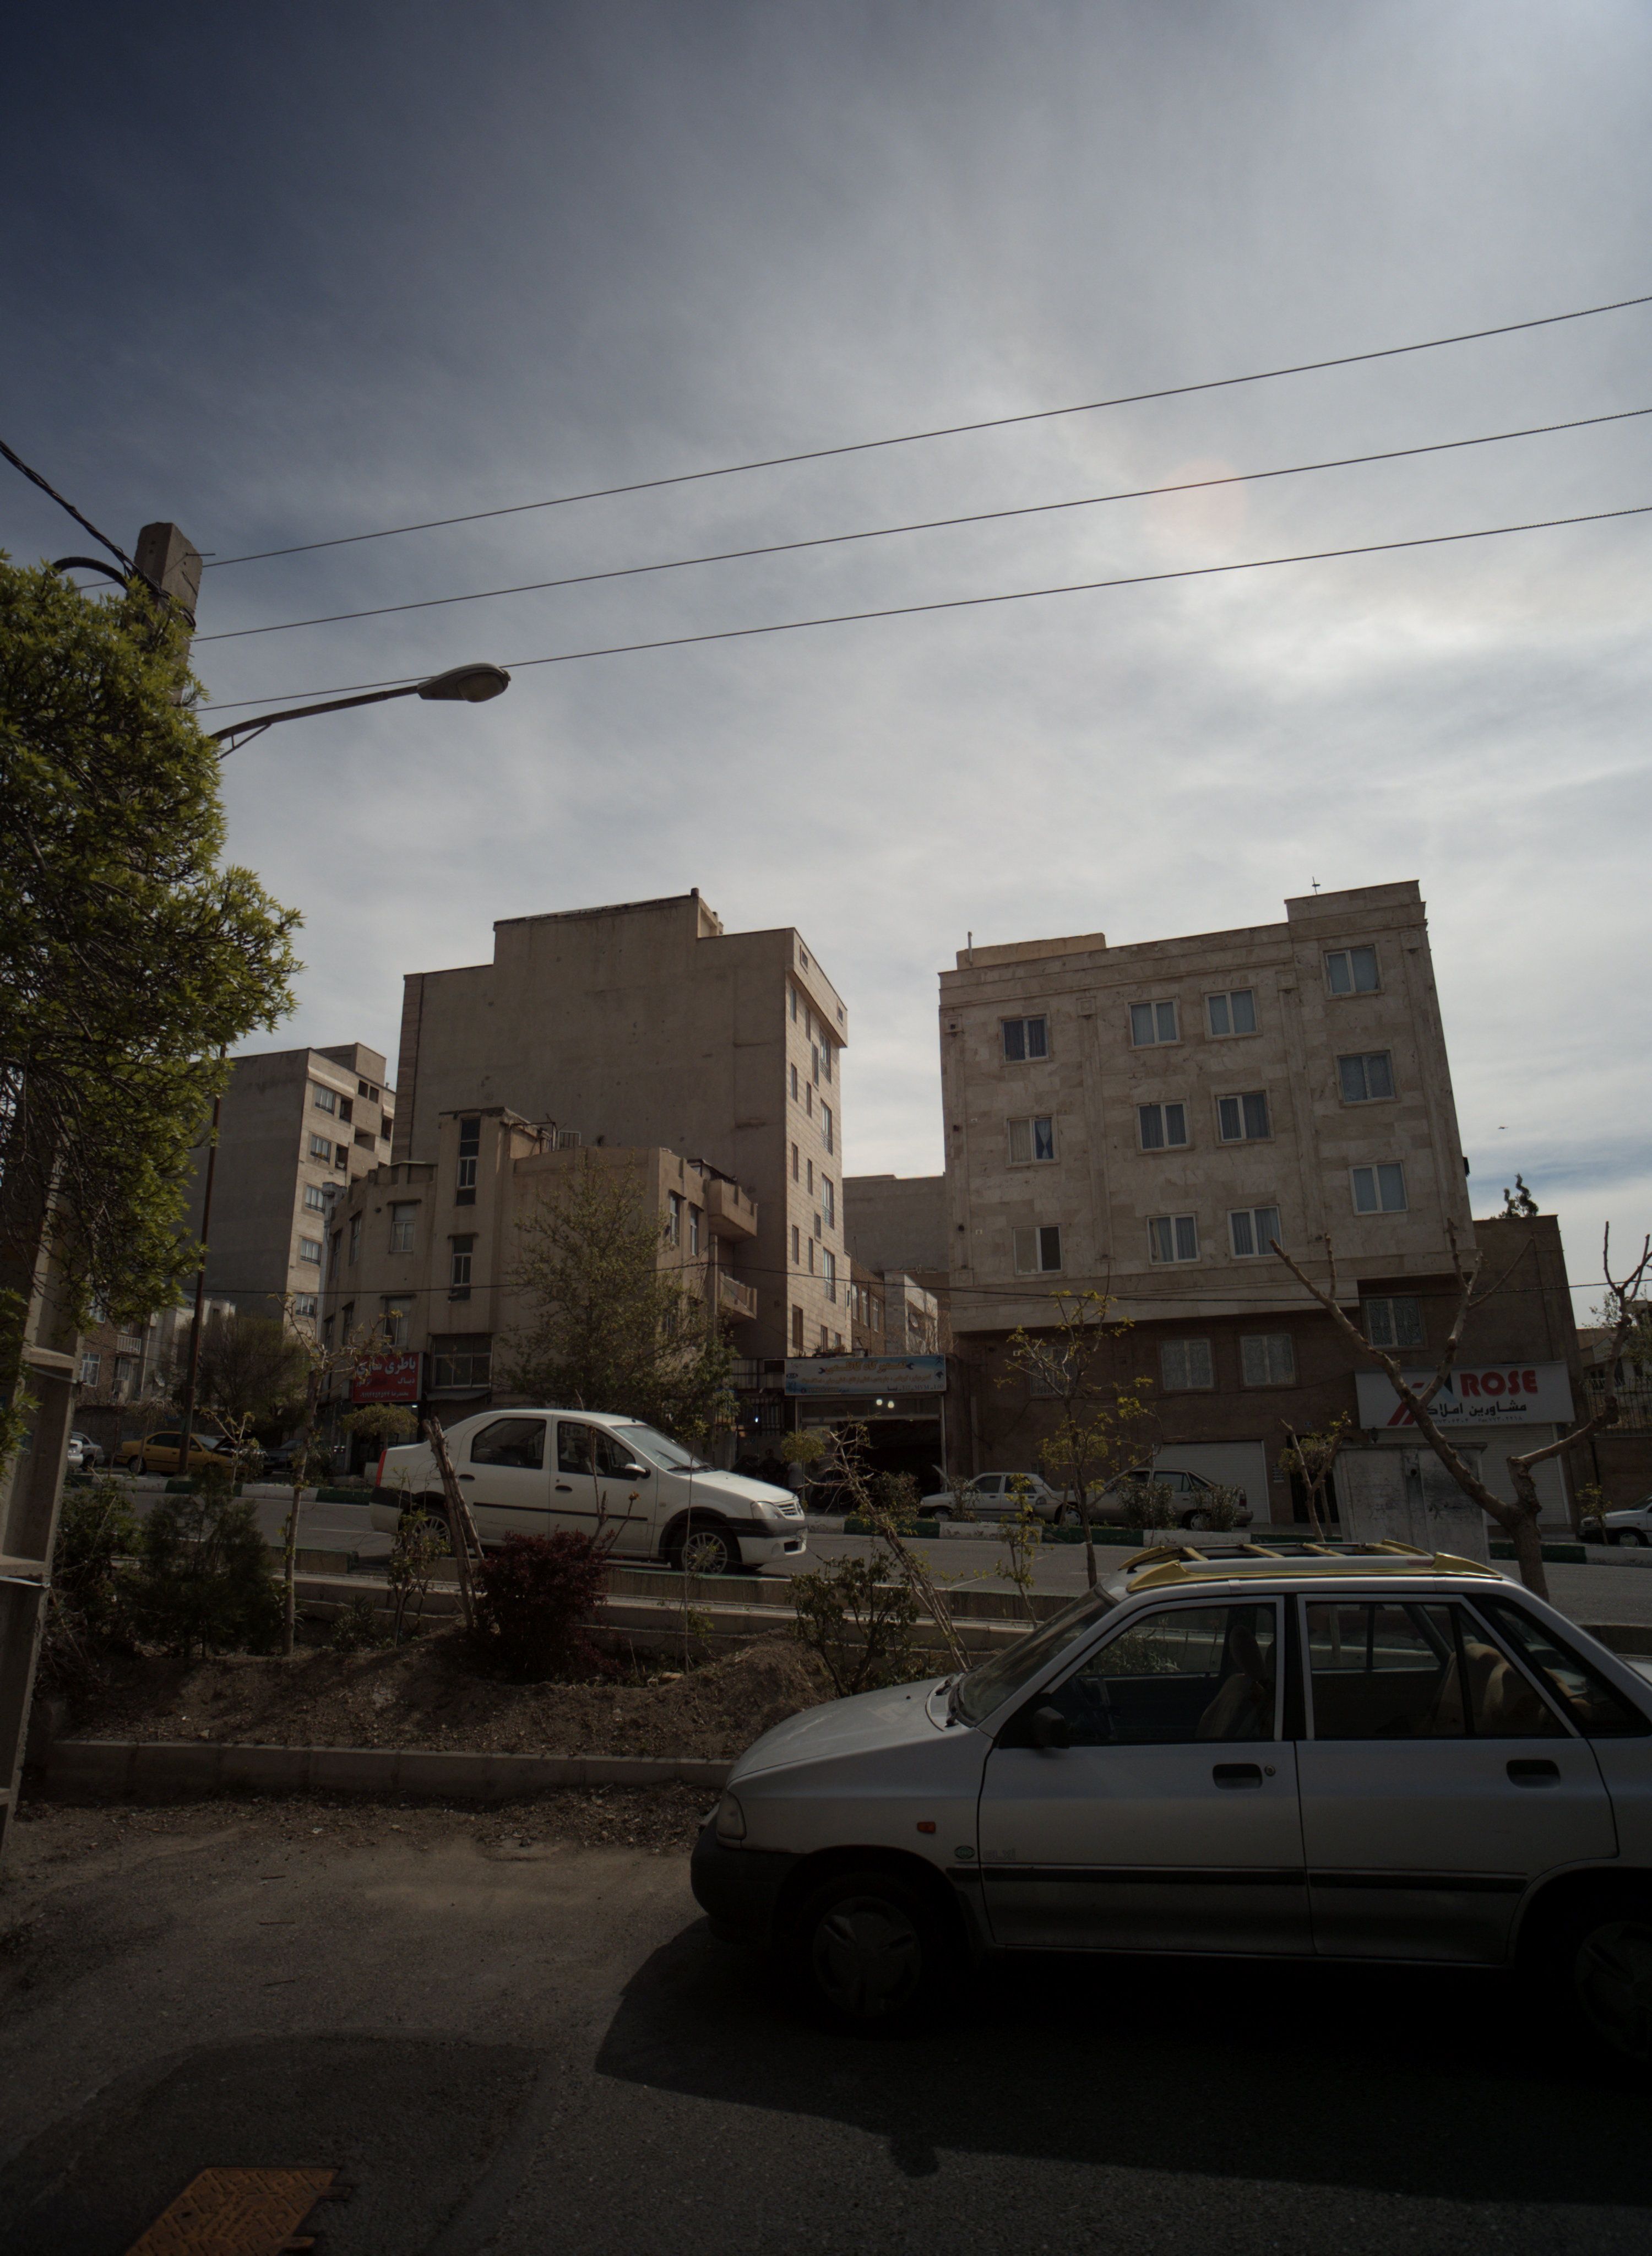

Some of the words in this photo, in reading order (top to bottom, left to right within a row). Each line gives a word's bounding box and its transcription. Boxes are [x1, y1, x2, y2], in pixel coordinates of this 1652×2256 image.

[384, 1357, 416, 1375] باطری
[1460, 1370, 1538, 1397] ROSE
[1469, 1400, 1527, 1416] مشاورین
